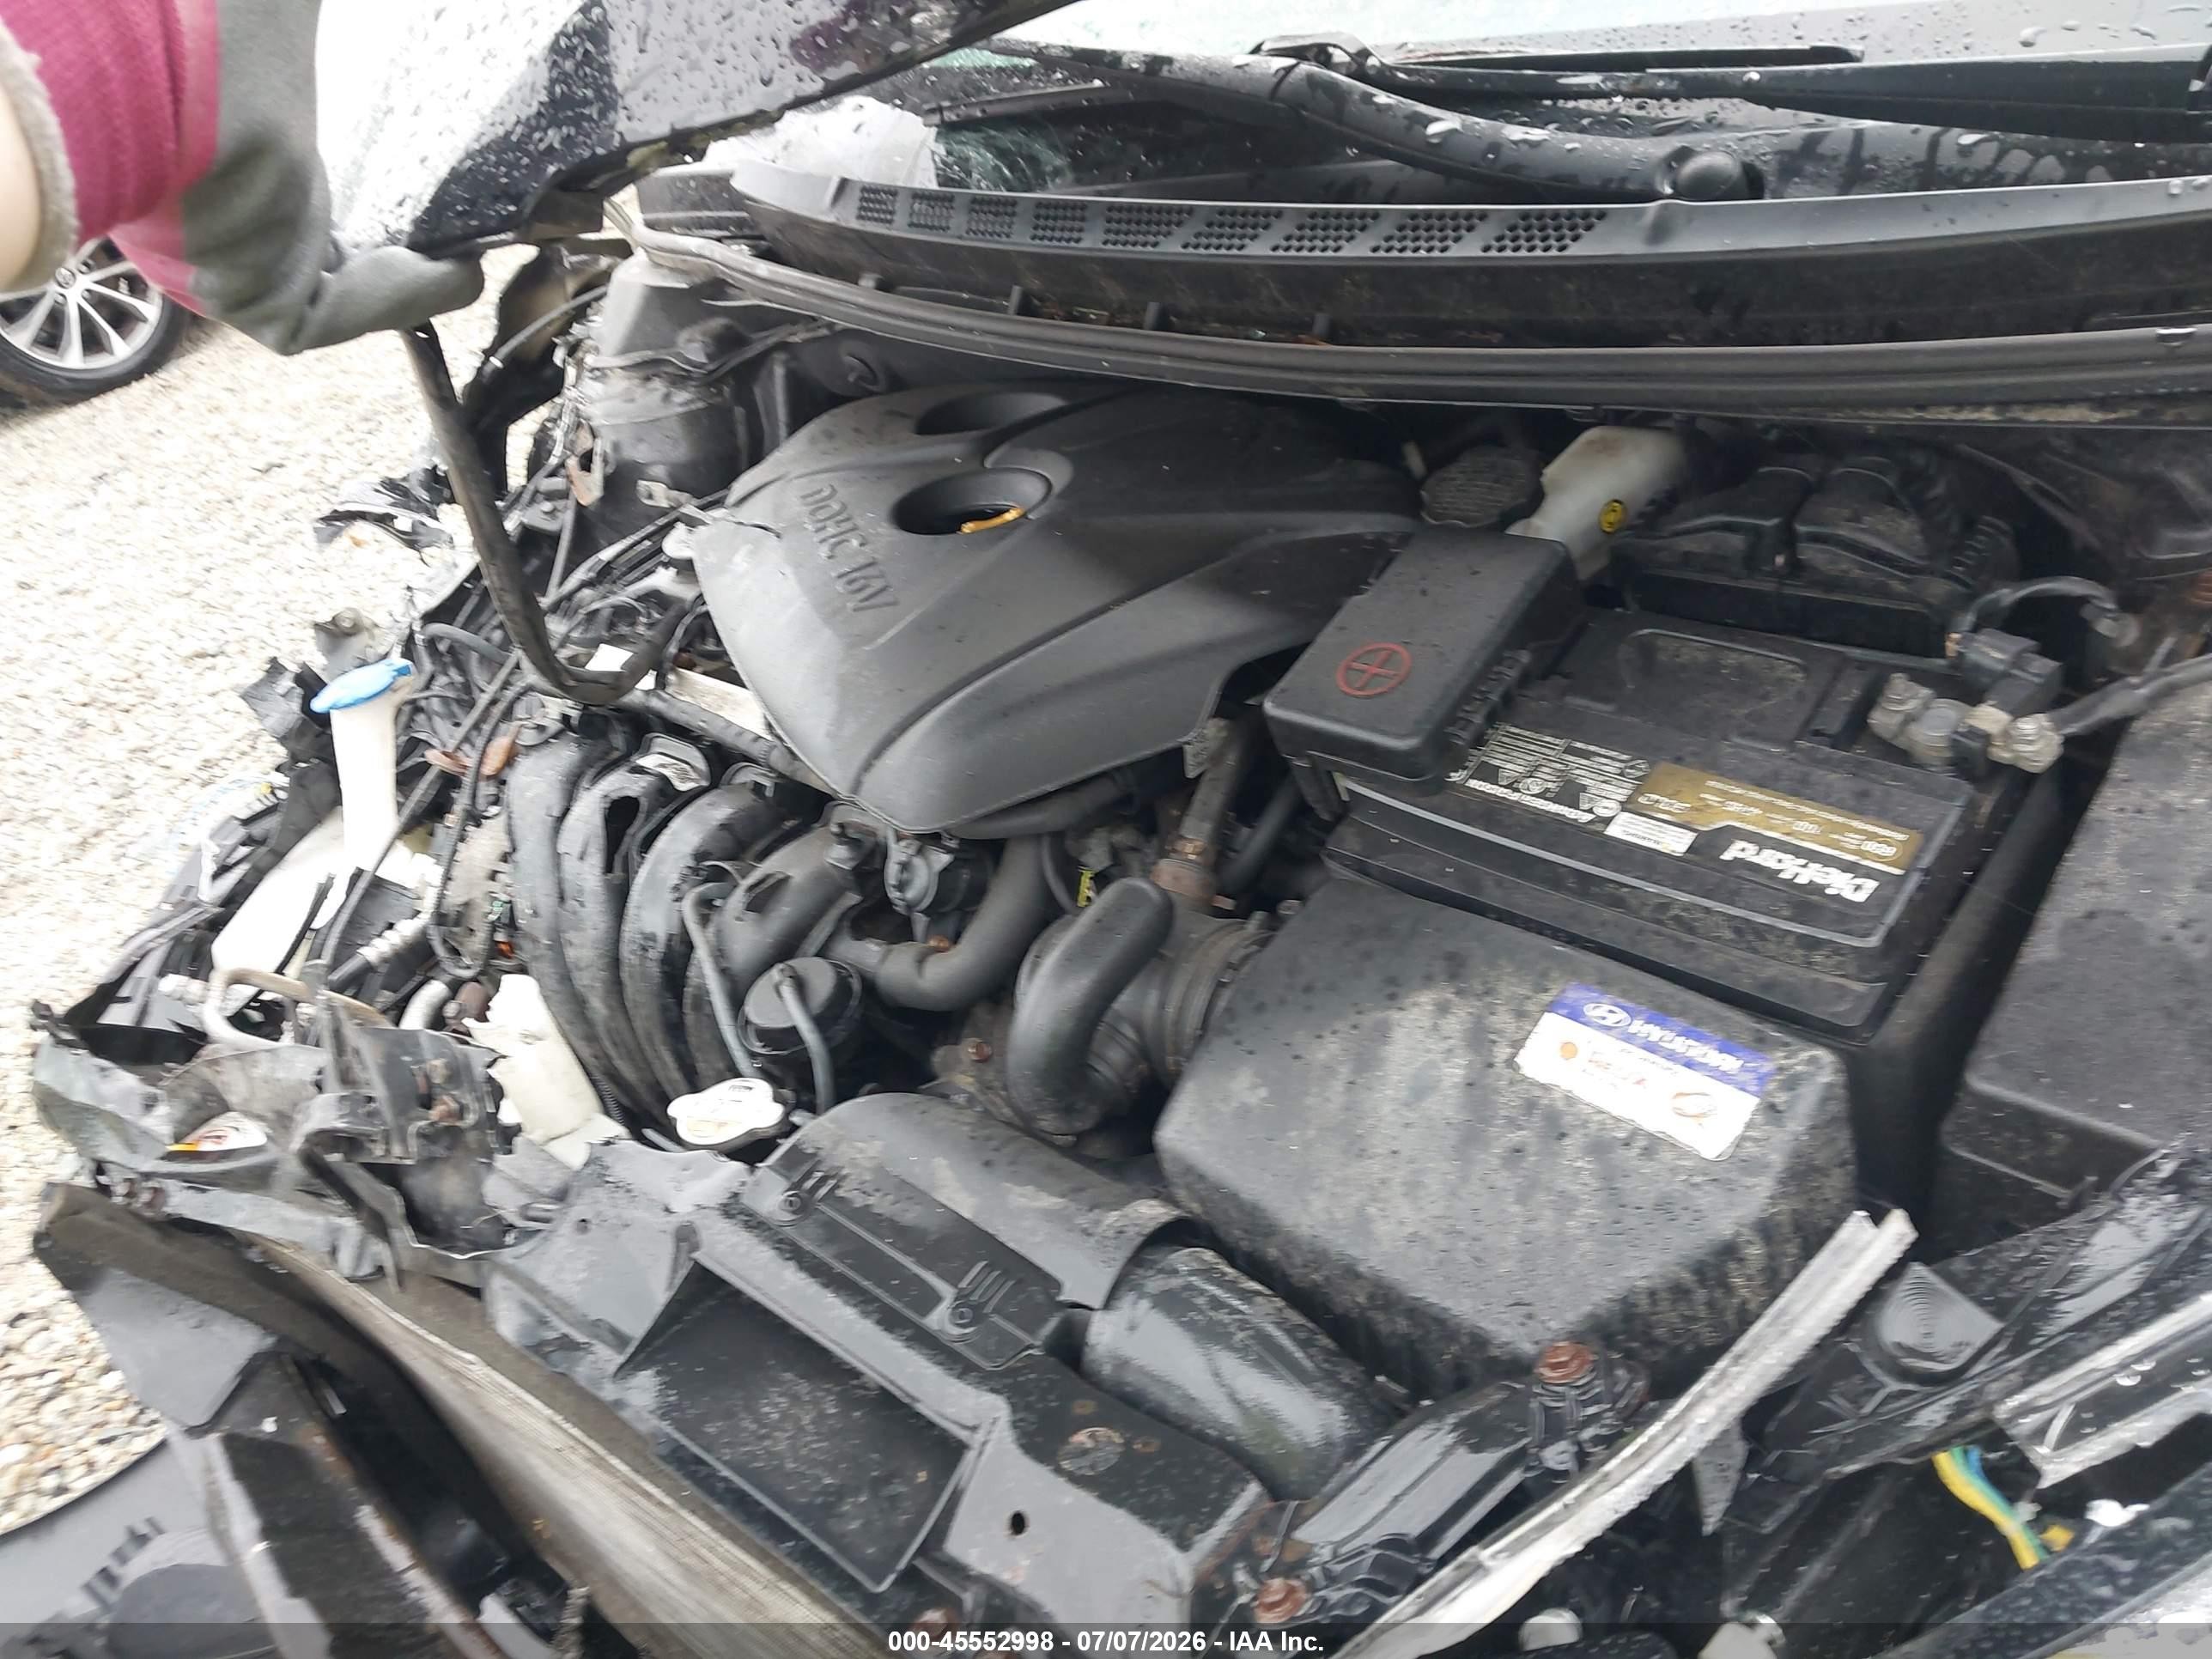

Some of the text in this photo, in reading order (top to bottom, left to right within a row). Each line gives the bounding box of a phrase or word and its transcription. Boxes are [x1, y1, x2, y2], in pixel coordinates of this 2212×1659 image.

[799, 483, 901, 613] DOHC 16V
[1719, 838, 1881, 902] DieHard
